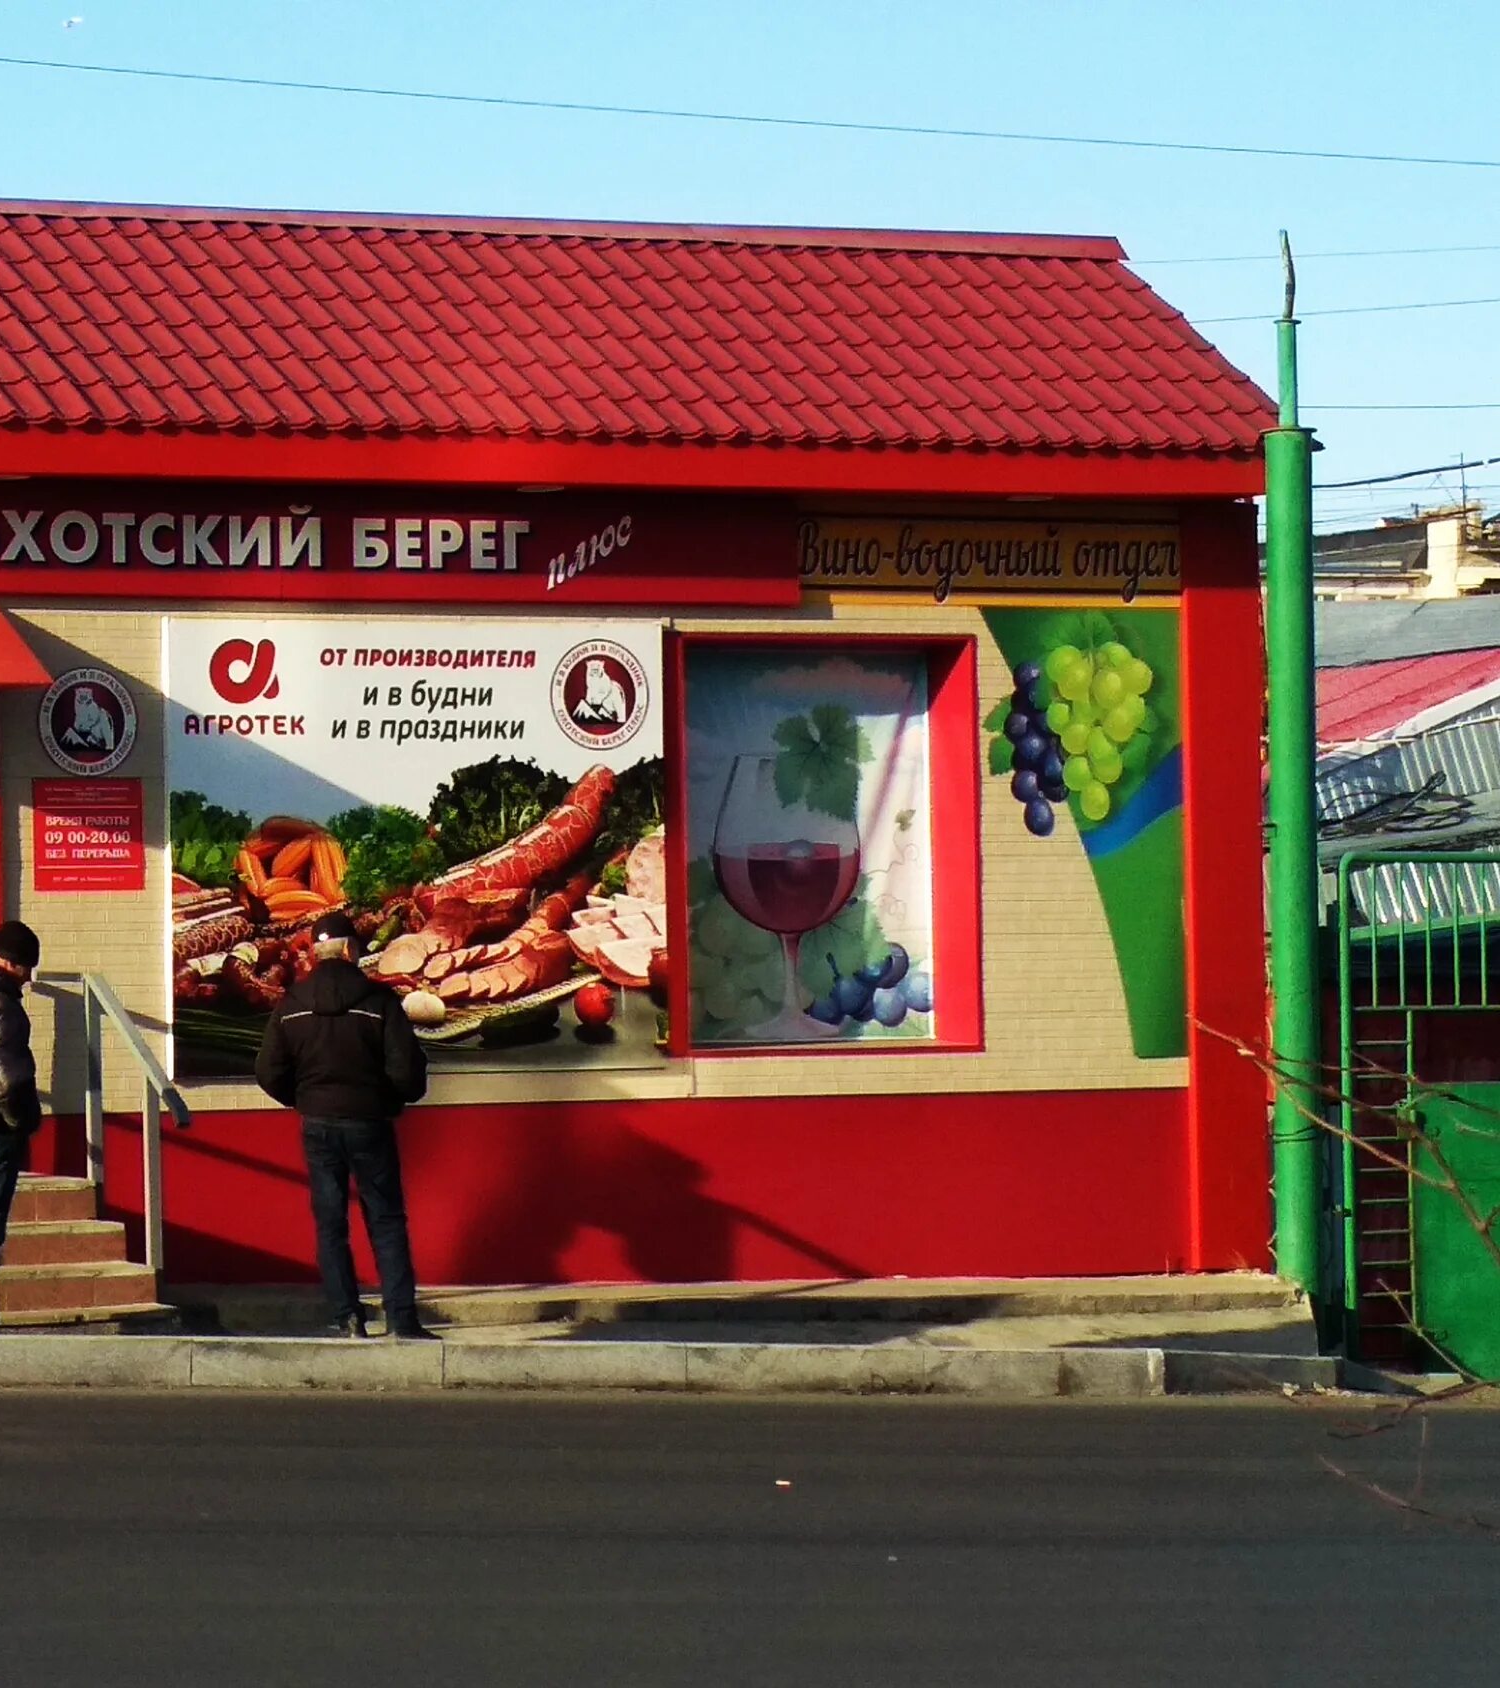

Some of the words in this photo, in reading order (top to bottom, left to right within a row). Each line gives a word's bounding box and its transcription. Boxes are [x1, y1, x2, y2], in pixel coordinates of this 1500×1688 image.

[352, 517, 530, 572] БЕРЕГ
[546, 515, 632, 591] плюс
[799, 520, 1062, 604] Вино-водочный
[1073, 537, 1181, 604] отдел
[319, 648, 348, 667] ОТ
[353, 648, 536, 670] ПРОИЗВОДИТЕЛЯ
[363, 686, 378, 707] и
[388, 686, 402, 707] в
[410, 679, 493, 708] будни
[184, 713, 305, 736] АГРОТЕК
[331, 719, 346, 739] и
[357, 719, 372, 739] в
[384, 717, 525, 746] праздники
[45, 848, 67, 859] БЕЗ
[71, 848, 131, 859] ПЕРЕРЫВА
